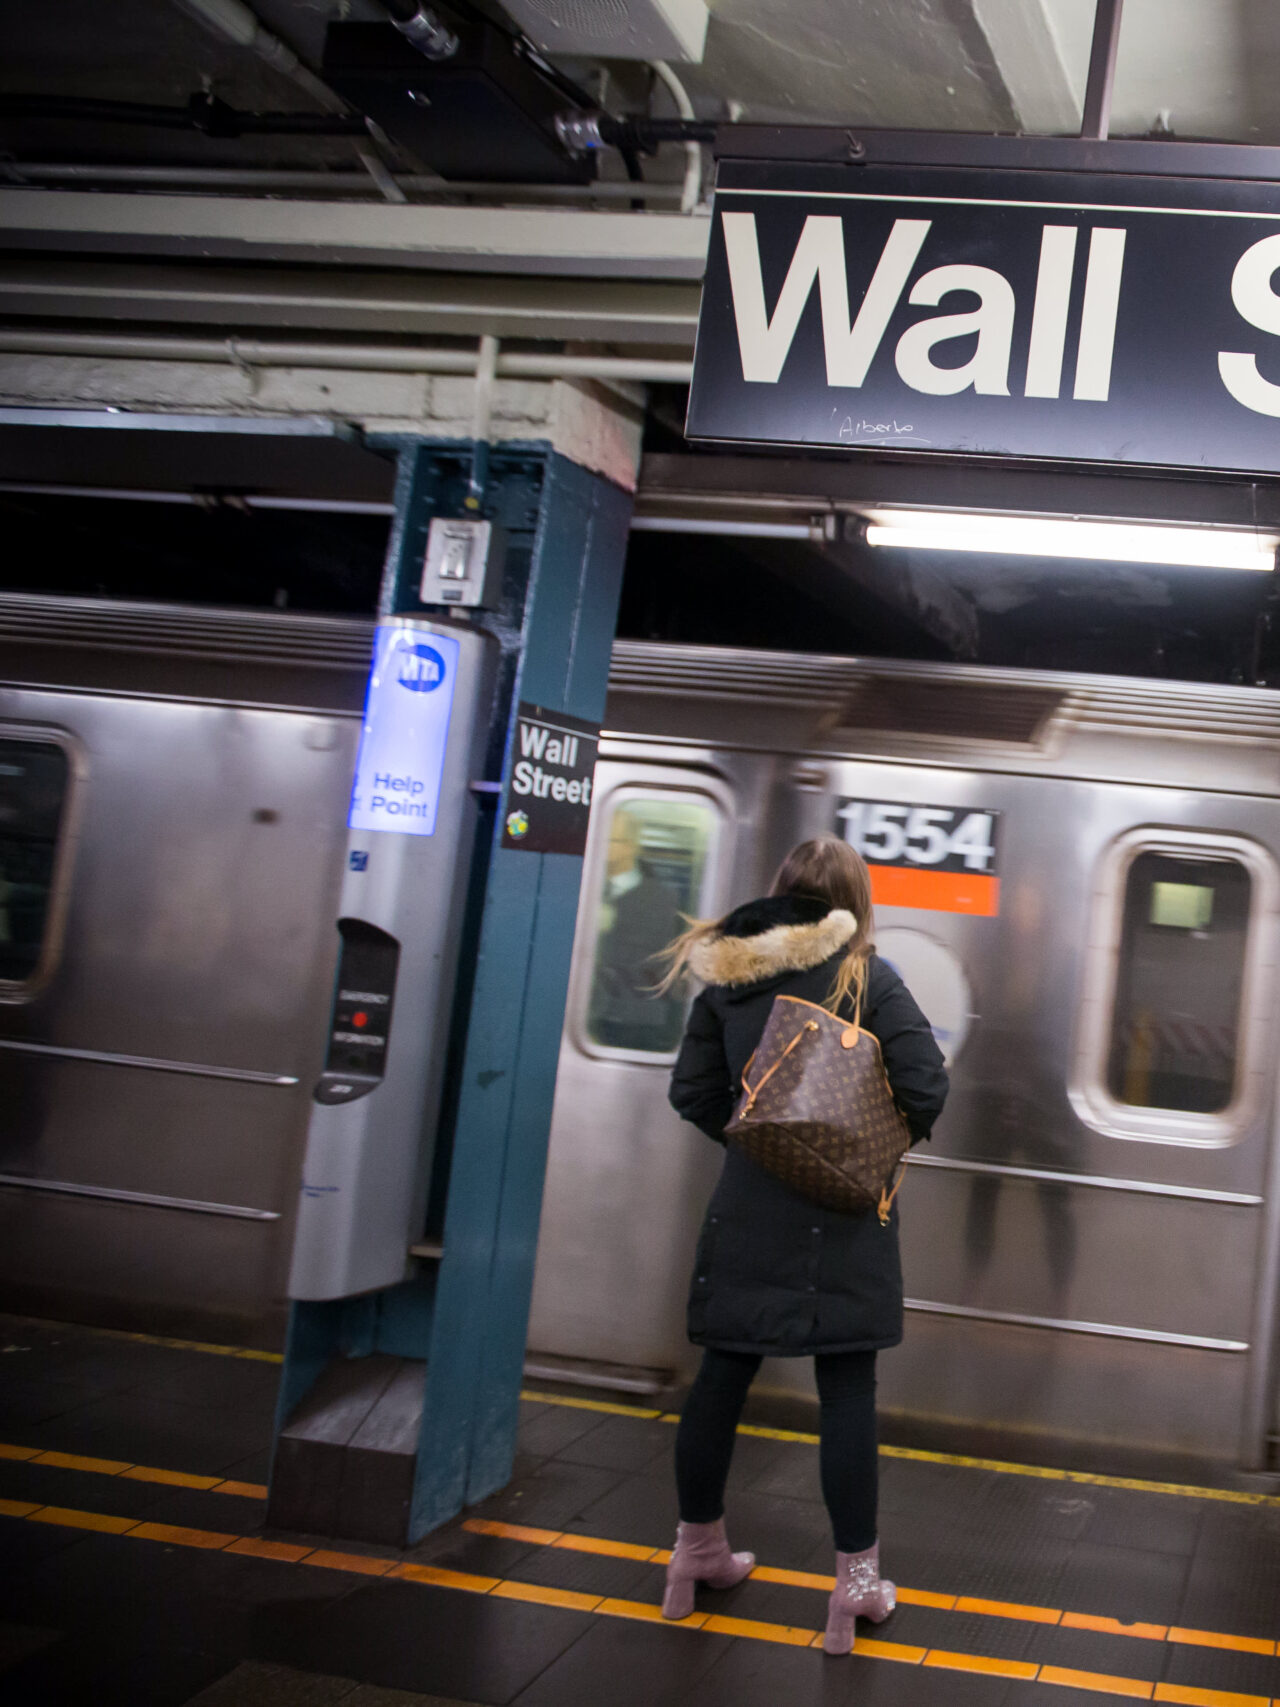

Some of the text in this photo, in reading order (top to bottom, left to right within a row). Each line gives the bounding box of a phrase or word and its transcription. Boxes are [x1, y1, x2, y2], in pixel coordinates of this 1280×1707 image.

[721, 211, 1127, 402] Wall
[398, 648, 441, 682] MTA
[520, 723, 579, 767] Wall
[373, 771, 425, 796] Help
[512, 761, 592, 806] Street
[369, 795, 428, 818] Point
[837, 801, 996, 870] 1554
